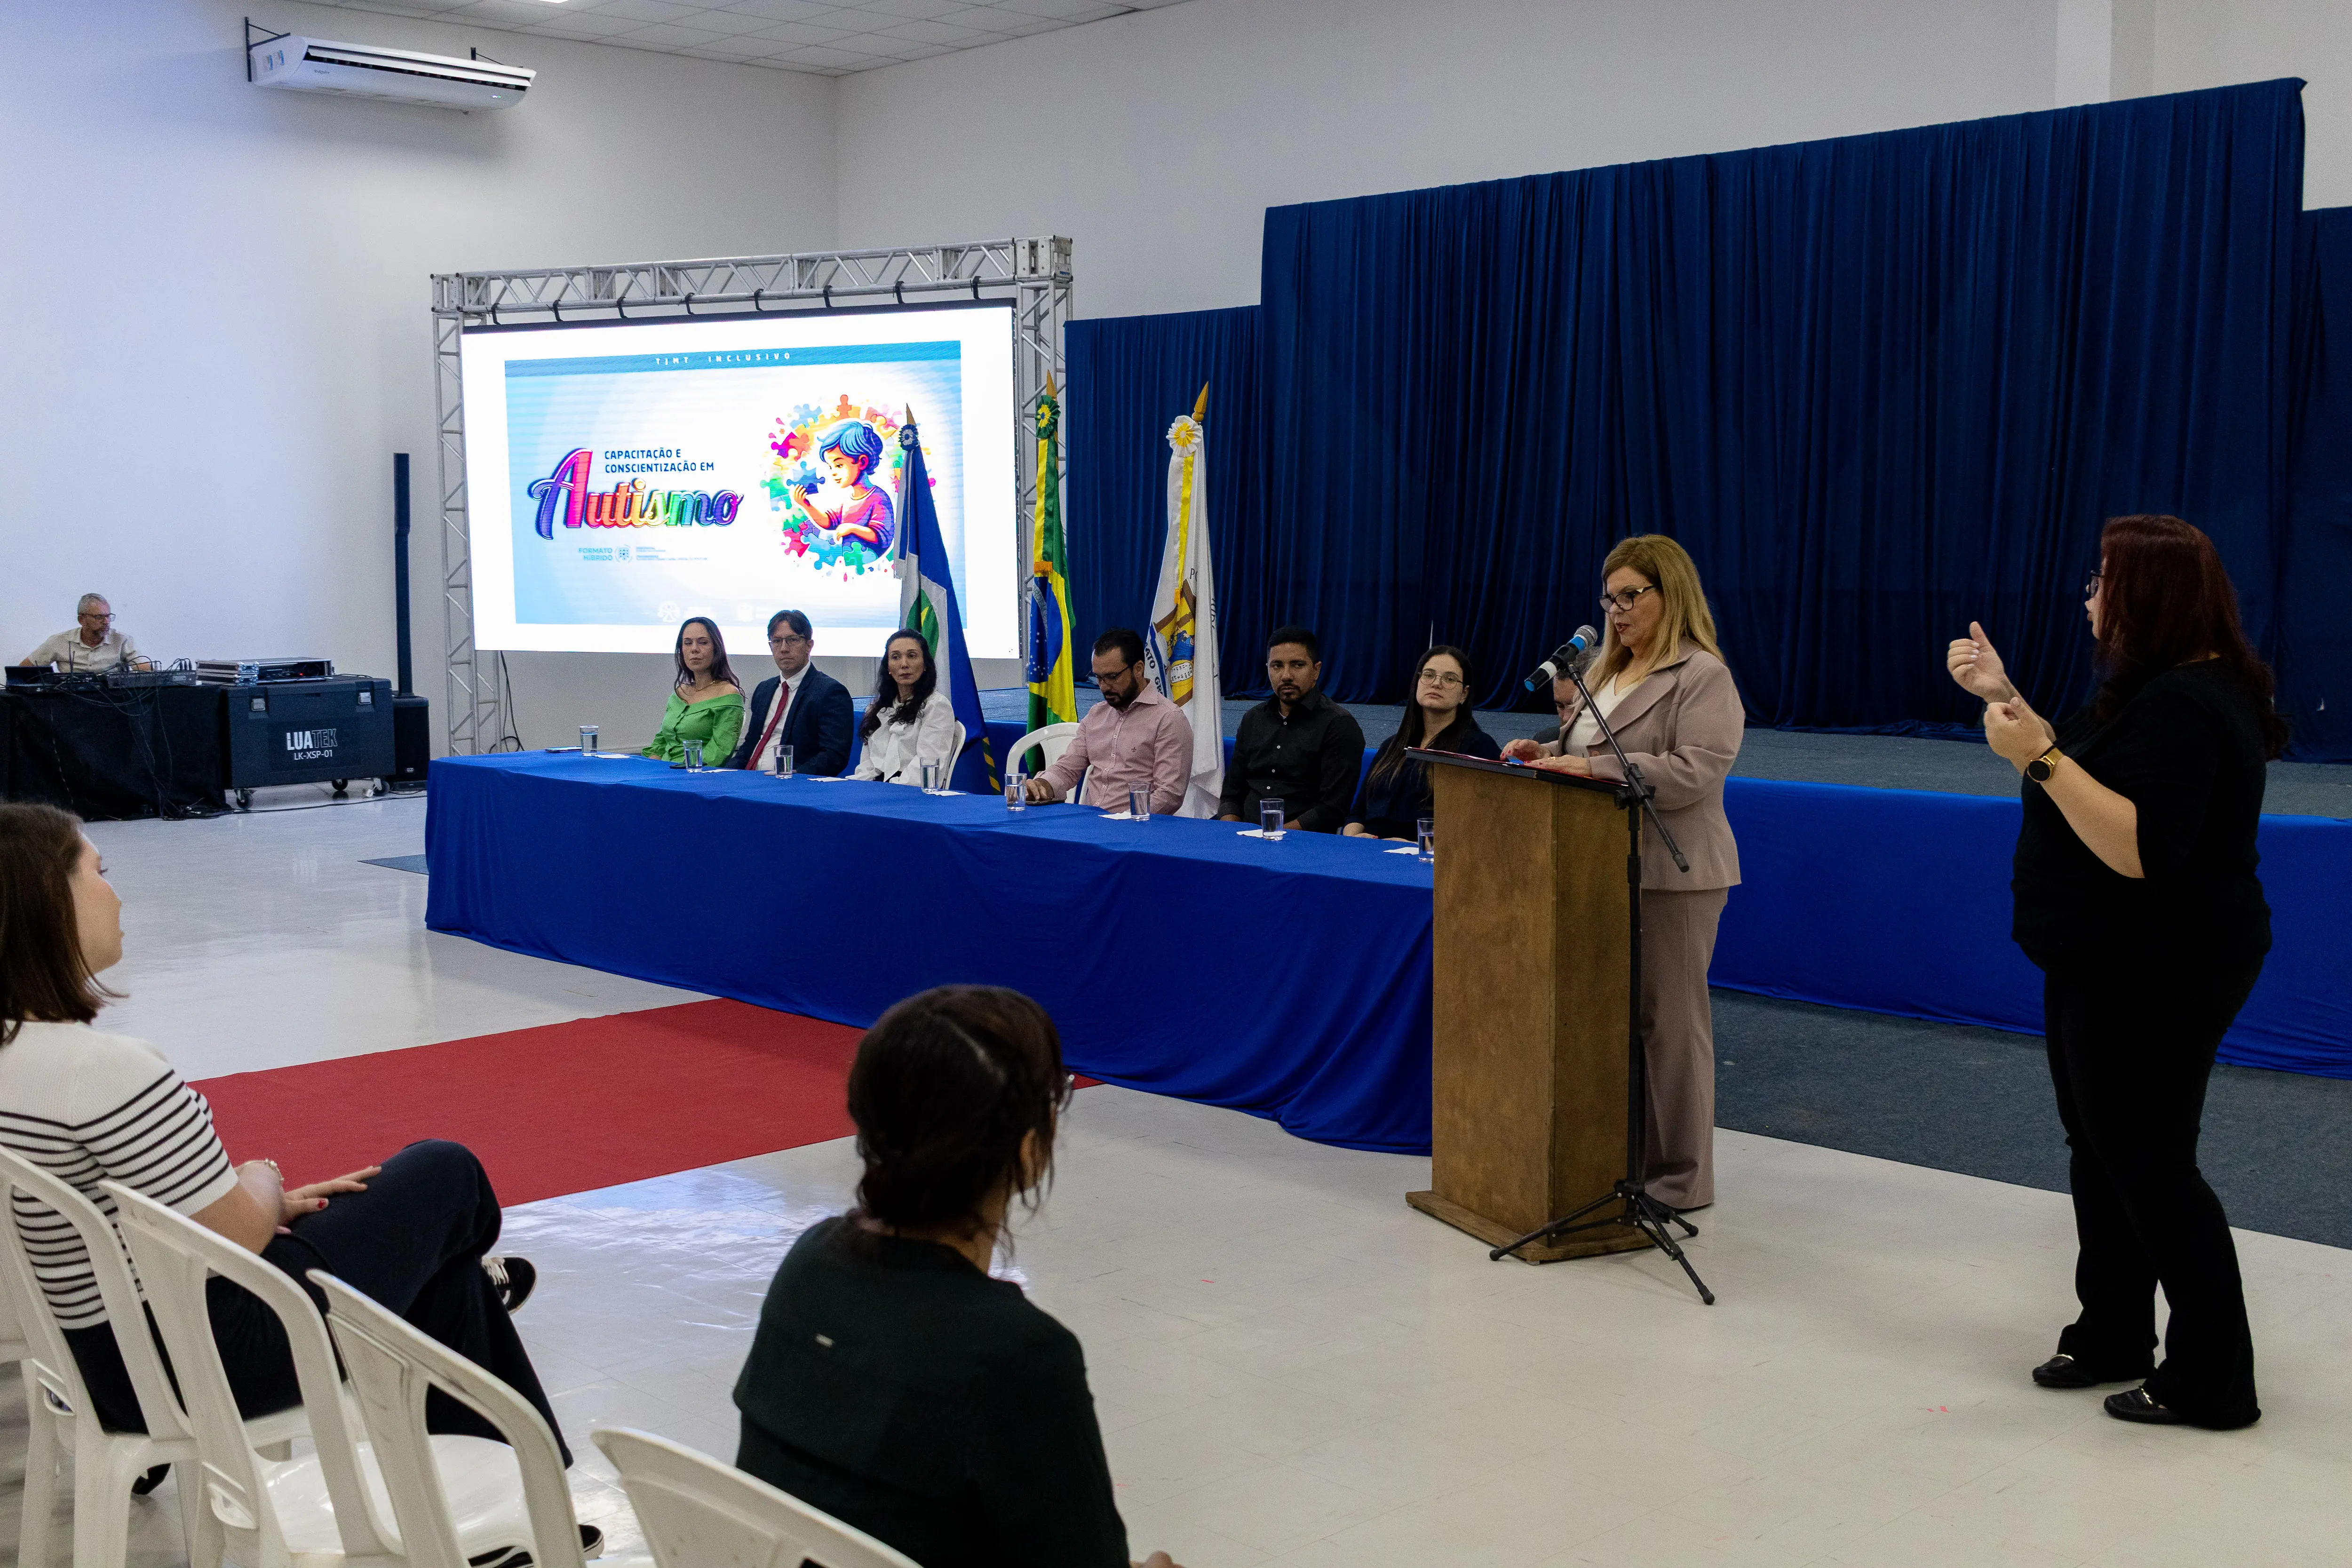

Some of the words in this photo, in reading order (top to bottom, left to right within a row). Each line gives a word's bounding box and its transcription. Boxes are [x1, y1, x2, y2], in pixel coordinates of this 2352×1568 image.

[707, 352, 790, 363] INCLUSIVO
[604, 447, 672, 461] CAPACITAÇÃO
[676, 449, 681, 458] E
[605, 460, 696, 473] CONSCIENTIZAÇÃO
[700, 462, 714, 471] EM
[527, 447, 744, 541] Autismo
[1145, 642, 1156, 669] ATO
[286, 728, 338, 750] LUATEK
[294, 749, 333, 760] LK-XSP-01
